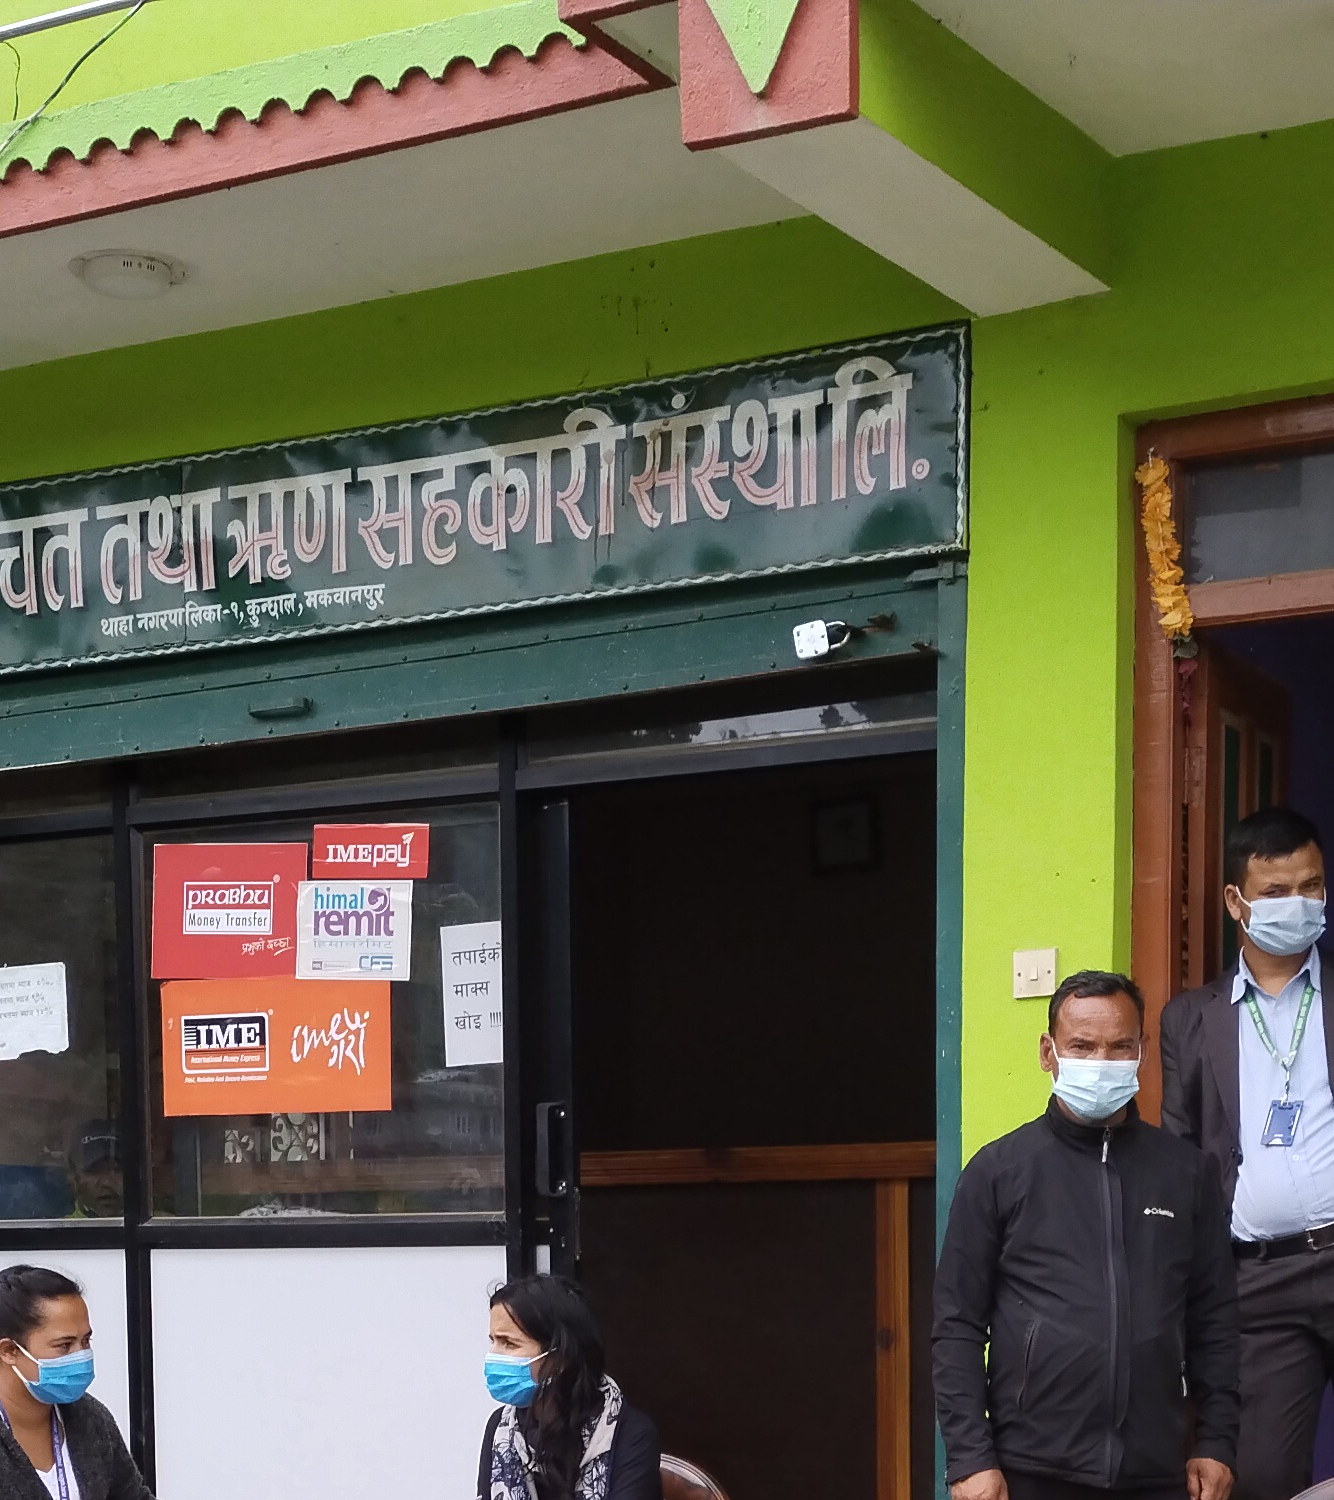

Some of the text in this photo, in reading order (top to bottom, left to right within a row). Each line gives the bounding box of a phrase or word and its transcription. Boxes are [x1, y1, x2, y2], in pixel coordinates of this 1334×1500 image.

[96, 487, 221, 602] तथा
[227, 467, 352, 585] ऋण
[358, 408, 627, 569] सहकारी
[100, 614, 135, 637] थाहा
[304, 583, 386, 611] मकवानपुर
[314, 886, 364, 910] himal
[188, 912, 268, 929] Money Transfer
[313, 897, 395, 937] remit
[453, 980, 490, 998] माक्स
[196, 1022, 261, 1050] IME
